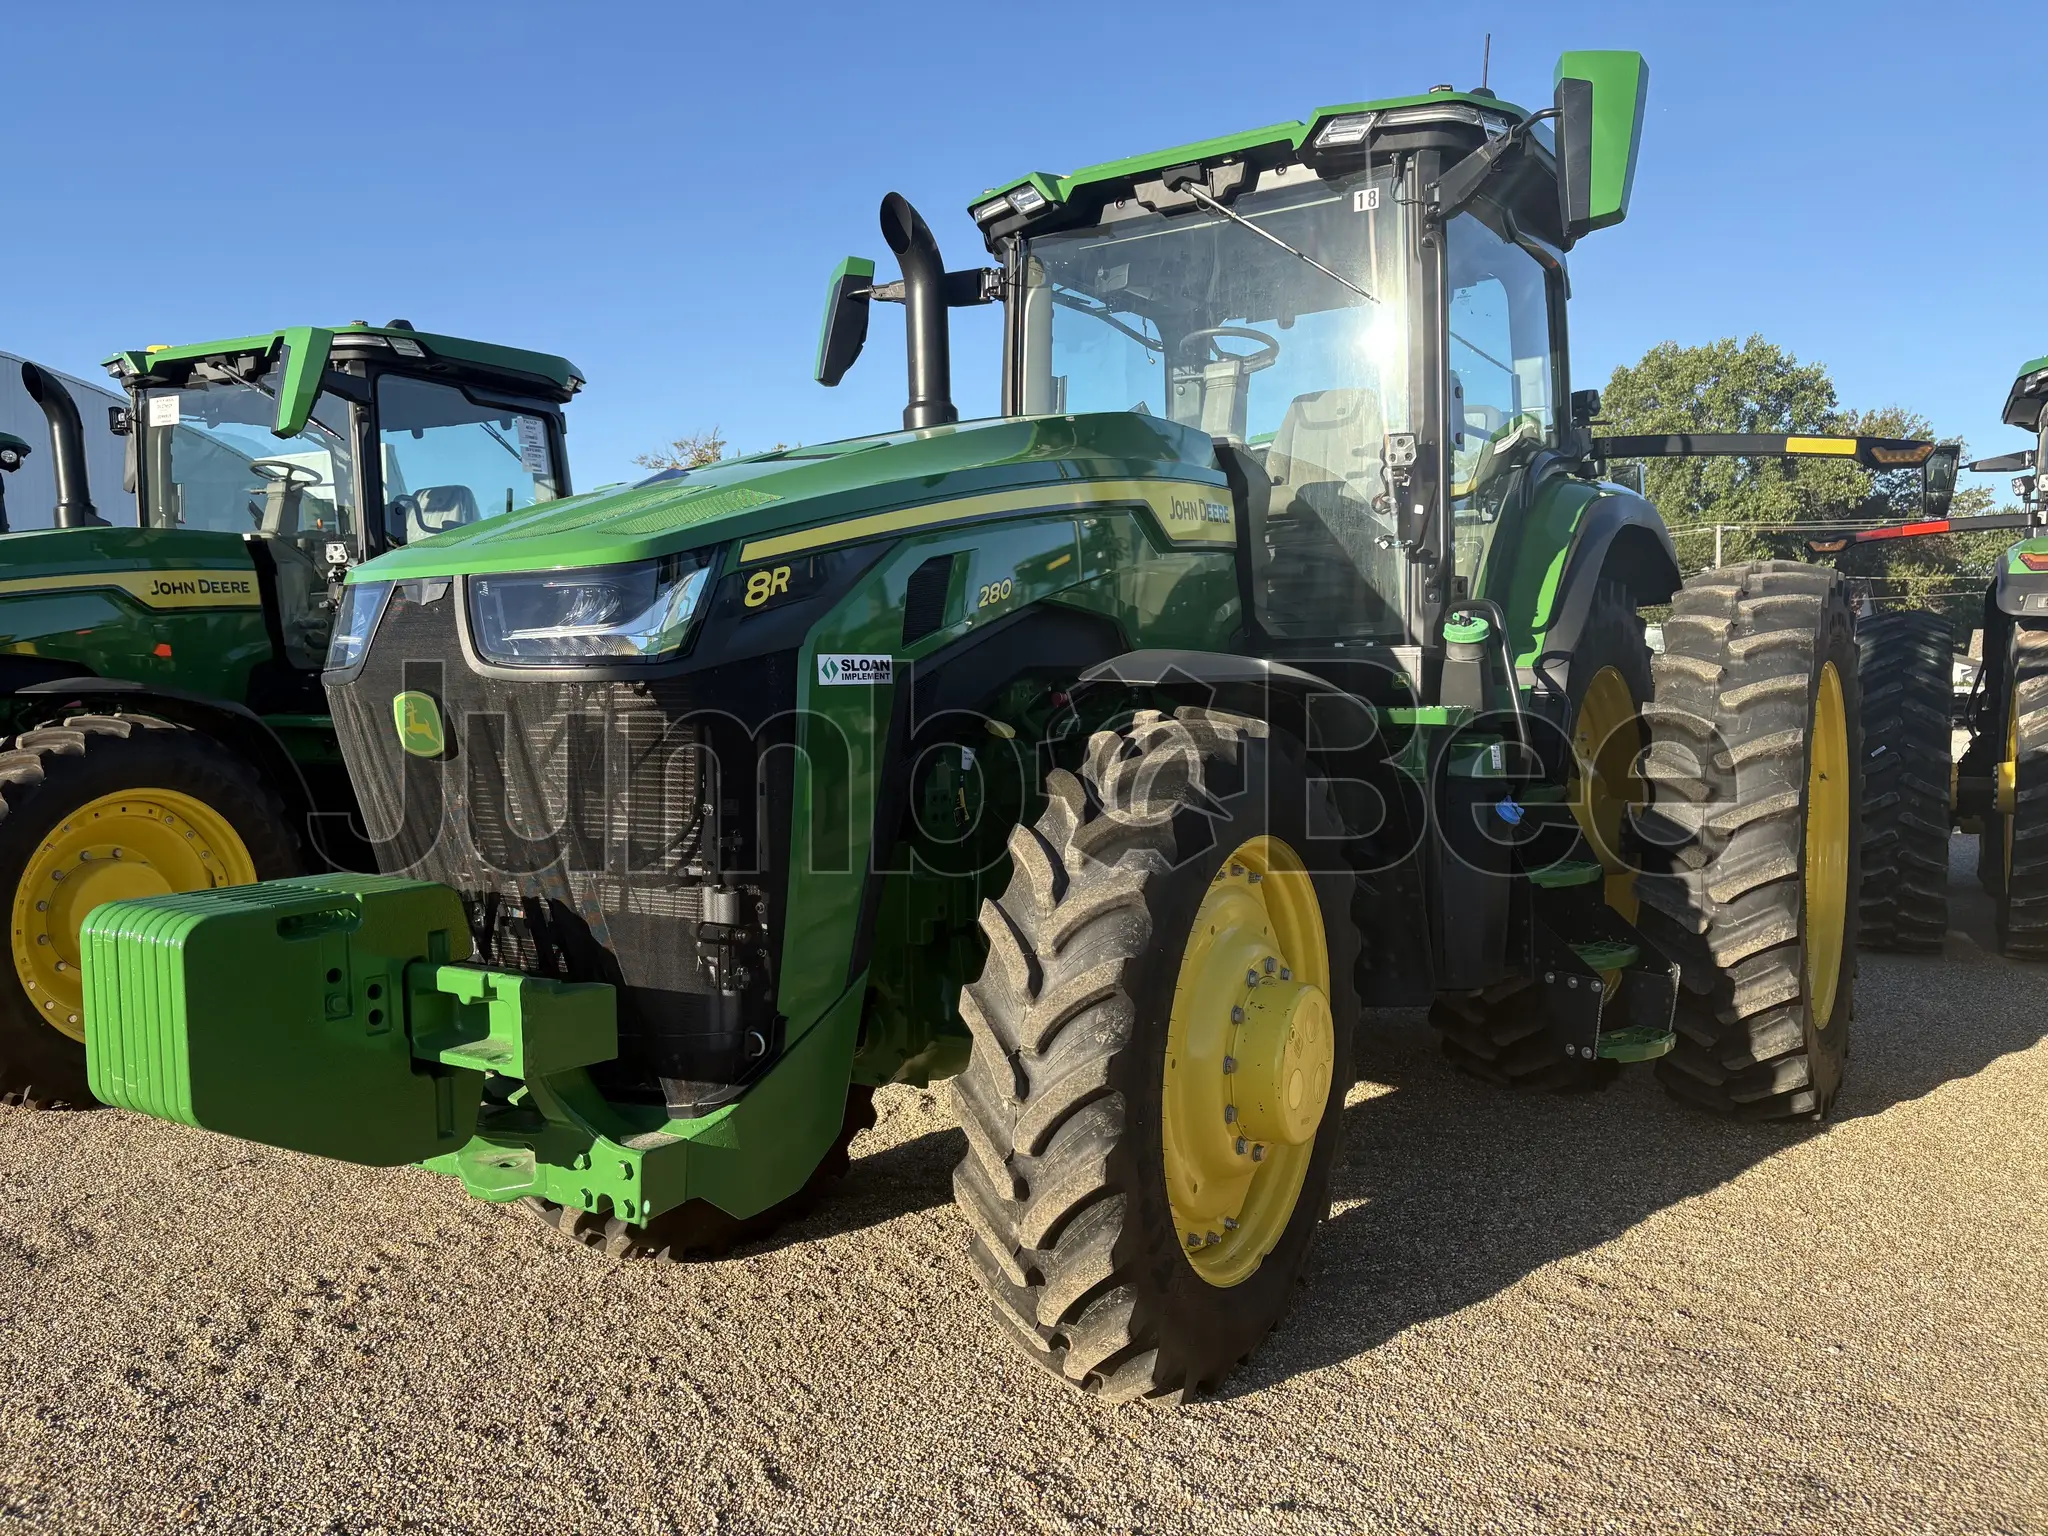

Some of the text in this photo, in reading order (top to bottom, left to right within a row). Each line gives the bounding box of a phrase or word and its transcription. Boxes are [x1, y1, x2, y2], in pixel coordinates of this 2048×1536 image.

[1358, 190, 1376, 209] 18
[1170, 496, 1230, 523] JOHN DEERE
[151, 579, 251, 595] JOHN DEERE
[744, 565, 791, 608] 8R
[978, 577, 1012, 608] 280
[841, 659, 891, 671] SLOAN
[841, 672, 891, 681] IMPLEMENT
